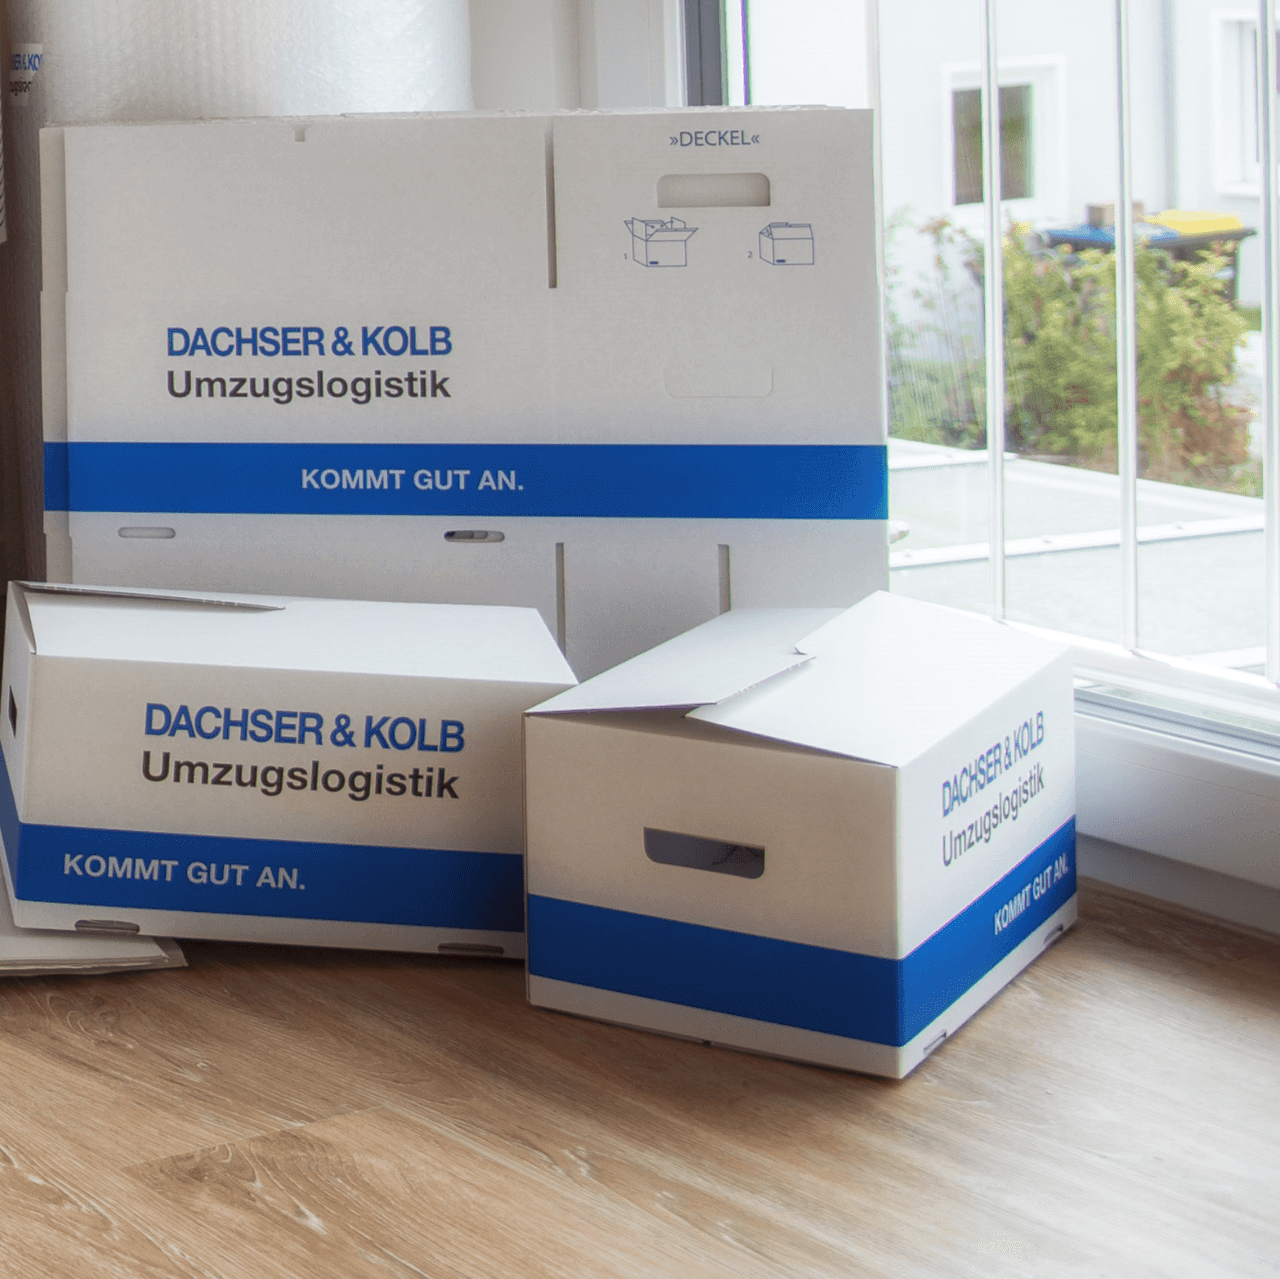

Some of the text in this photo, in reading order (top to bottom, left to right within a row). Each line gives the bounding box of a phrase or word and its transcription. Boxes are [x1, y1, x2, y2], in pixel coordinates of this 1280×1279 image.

[167, 325, 453, 358] DACHSER & KOLB
[167, 368, 451, 406] Umzugslogistik
[301, 468, 524, 492] KOMMT GUT AN.
[145, 702, 466, 753] DACHSER & KOLB
[142, 751, 460, 801] Umzugslogistik
[942, 710, 1045, 818] DACHSER & KOLB
[942, 762, 1045, 867] Umzugslogistik
[63, 853, 306, 891] KOMMT GUT AN.
[994, 852, 1069, 936] KOMMT GUT AN.
